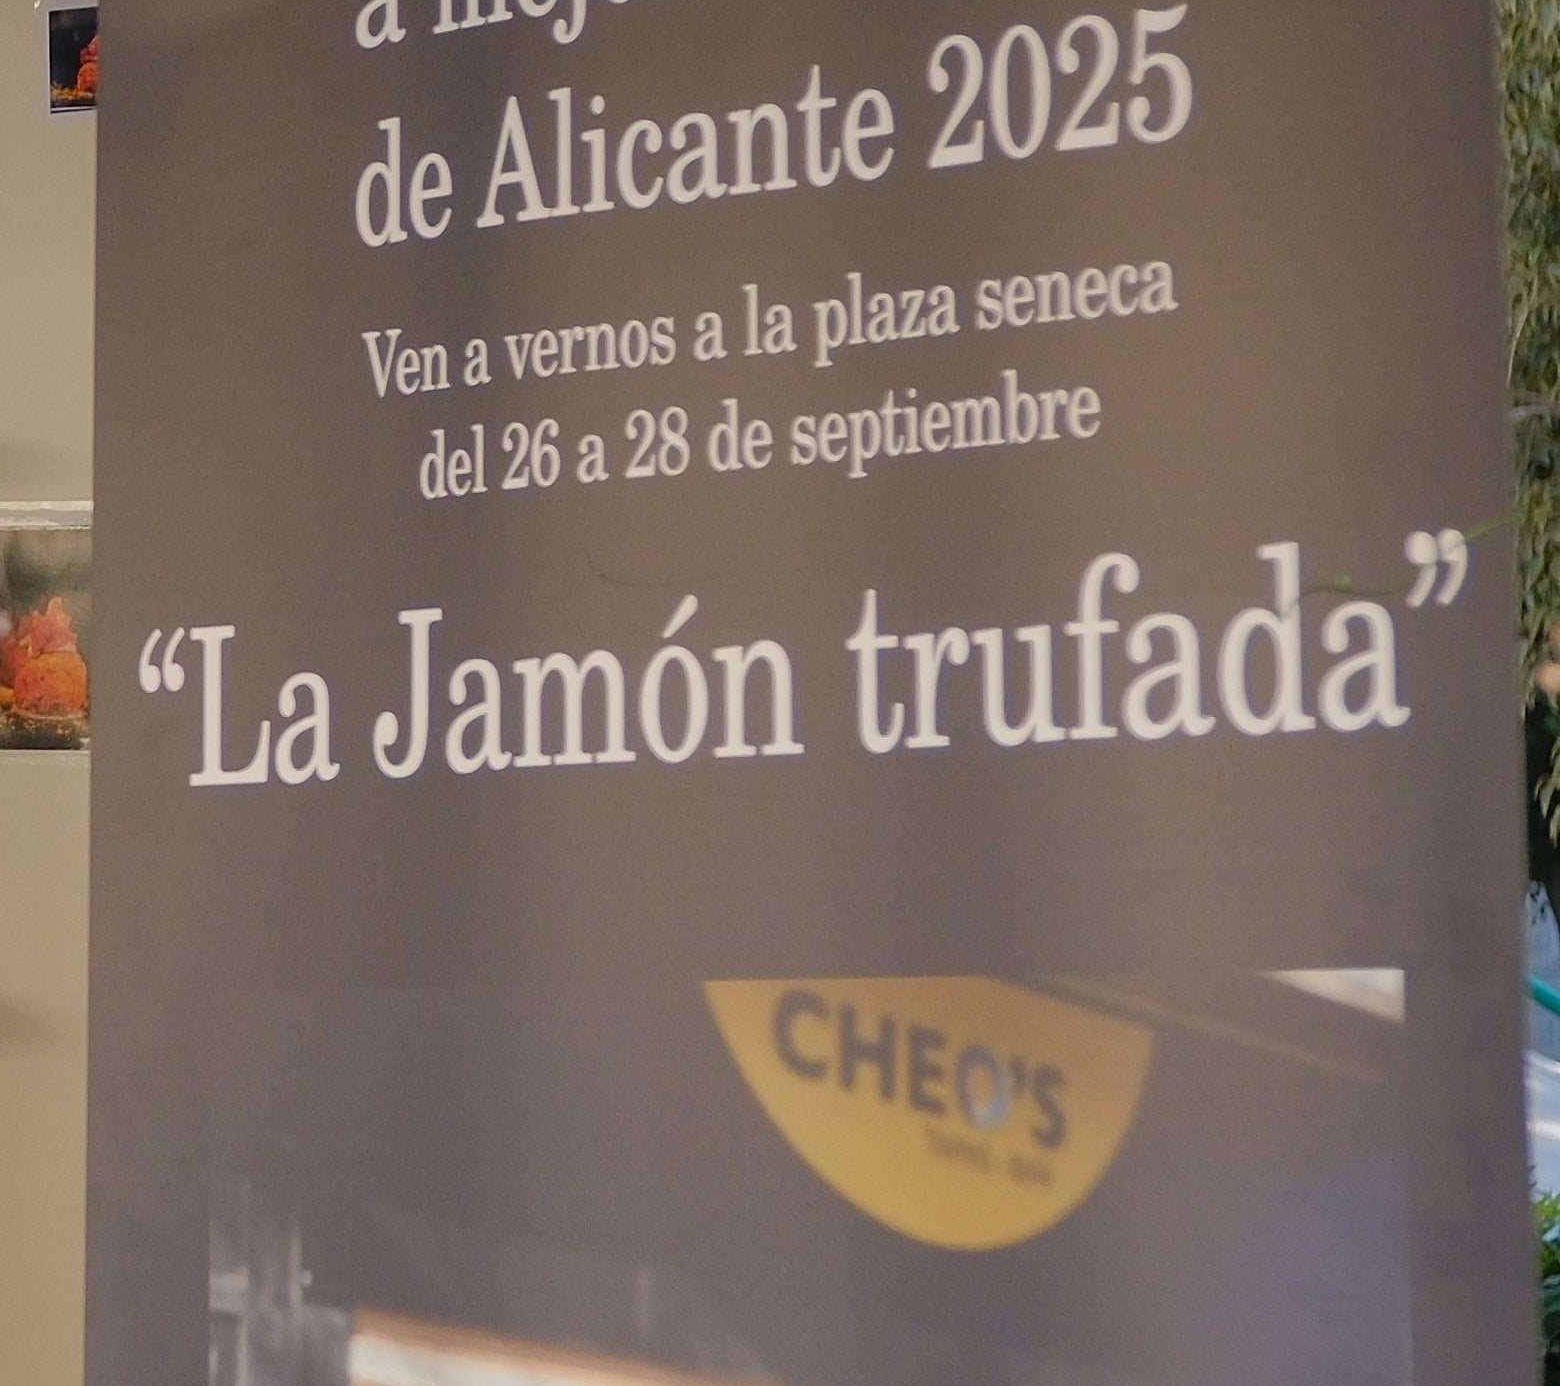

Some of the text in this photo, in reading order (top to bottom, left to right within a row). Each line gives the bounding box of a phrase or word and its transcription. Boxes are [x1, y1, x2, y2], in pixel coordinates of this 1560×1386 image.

[354, 3, 1194, 249] de Alicante 2025
[361, 260, 1180, 399] Ven a vernos a la plaza seneca
[420, 369, 1102, 501] del 26 a 28 de septiembre
[137, 529, 1470, 788] “La Jamón trufada”
